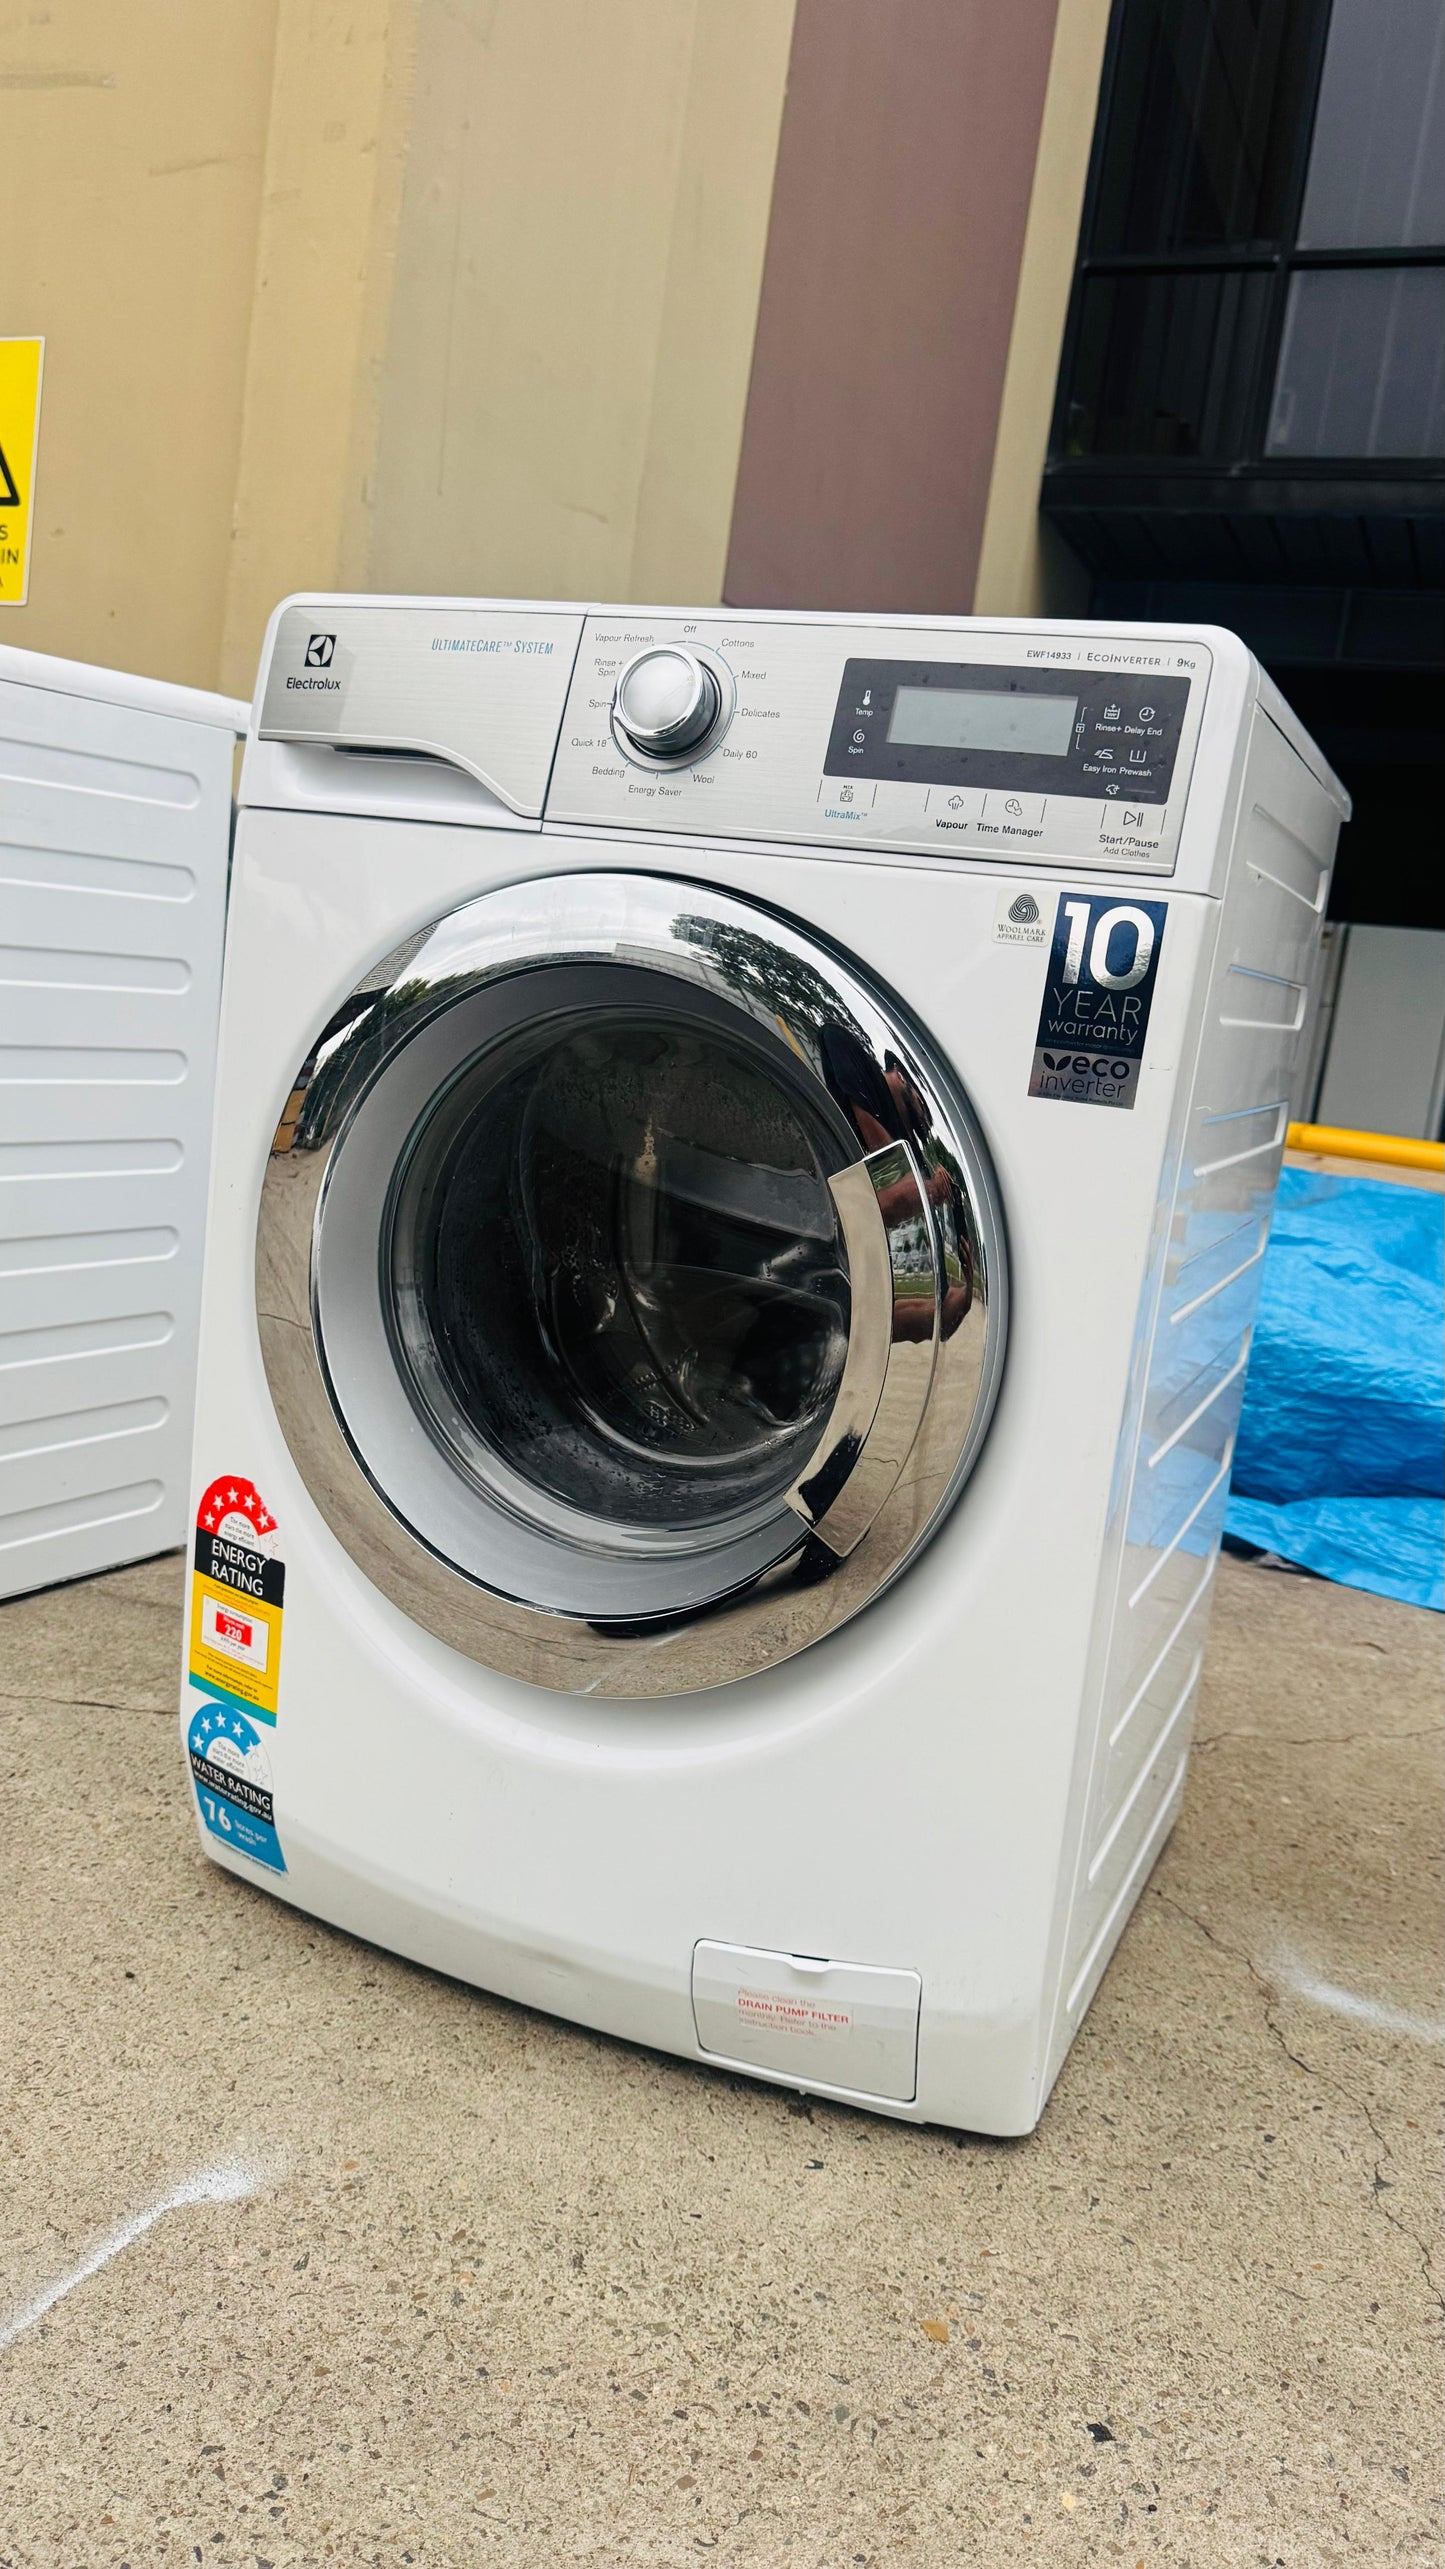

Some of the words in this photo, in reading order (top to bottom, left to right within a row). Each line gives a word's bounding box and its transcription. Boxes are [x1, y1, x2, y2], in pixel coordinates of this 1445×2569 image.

[683, 625, 697, 634] Off
[594, 633, 621, 643] Vapour
[624, 634, 654, 643] Refresh
[721, 638, 755, 648] Cottons
[514, 640, 554, 655] SYSTEM
[594, 658, 616, 667] Rinse
[1026, 650, 1072, 660] EWF14933
[1176, 658, 1196, 670] 9Kg
[598, 668, 615, 677] Spin
[741, 671, 767, 680] Mixed
[286, 677, 341, 690] Electrolux
[588, 699, 607, 709] Spin
[741, 708, 781, 719] Delicates
[855, 708, 873, 718] Temp
[1095, 723, 1122, 733] Rinse+
[1124, 725, 1146, 737] Delay
[1147, 727, 1163, 736] End
[571, 738, 594, 748] Quick
[597, 739, 607, 748] 18
[722, 749, 743, 760] Daily
[746, 750, 758, 759] 60
[848, 745, 864, 756] Spin
[592, 766, 625, 778] Bedding
[1083, 763, 1101, 775] Easy
[1102, 765, 1117, 774] Iron
[1119, 766, 1152, 777] Prewash
[693, 774, 715, 784] Wool
[628, 785, 656, 797] Energy
[658, 787, 682, 797] Saver
[935, 819, 968, 831] Vapour
[976, 823, 999, 833] Time
[1002, 825, 1044, 838] Manager
[1099, 834, 1159, 849] Start/Pause
[1103, 847, 1119, 855] Add
[1121, 848, 1150, 858] Clothes
[998, 924, 1046, 936] WOOLMARK
[997, 933, 1024, 941] APPAREL
[1026, 935, 1044, 943] CARE
[1062, 901, 1155, 991] 10
[1053, 988, 1142, 1025] YEAR
[1048, 1019, 1138, 1046] warranty
[1072, 1056, 1130, 1080] eco
[1039, 1071, 1126, 1099] inverter
[212, 1539, 266, 1575] ENERGY
[211, 1559, 263, 1596] RATING
[225, 1623, 242, 1641] 220
[191, 1752, 227, 1786] WATER
[228, 1777, 271, 1810] RATING
[203, 1796, 232, 1832] 76
[772, 1995, 797, 2005] clean
[800, 1999, 816, 2008] the
[738, 1998, 773, 2012] DRAIN
[776, 2005, 808, 2017] PUMP
[811, 2011, 849, 2024] FILTER
